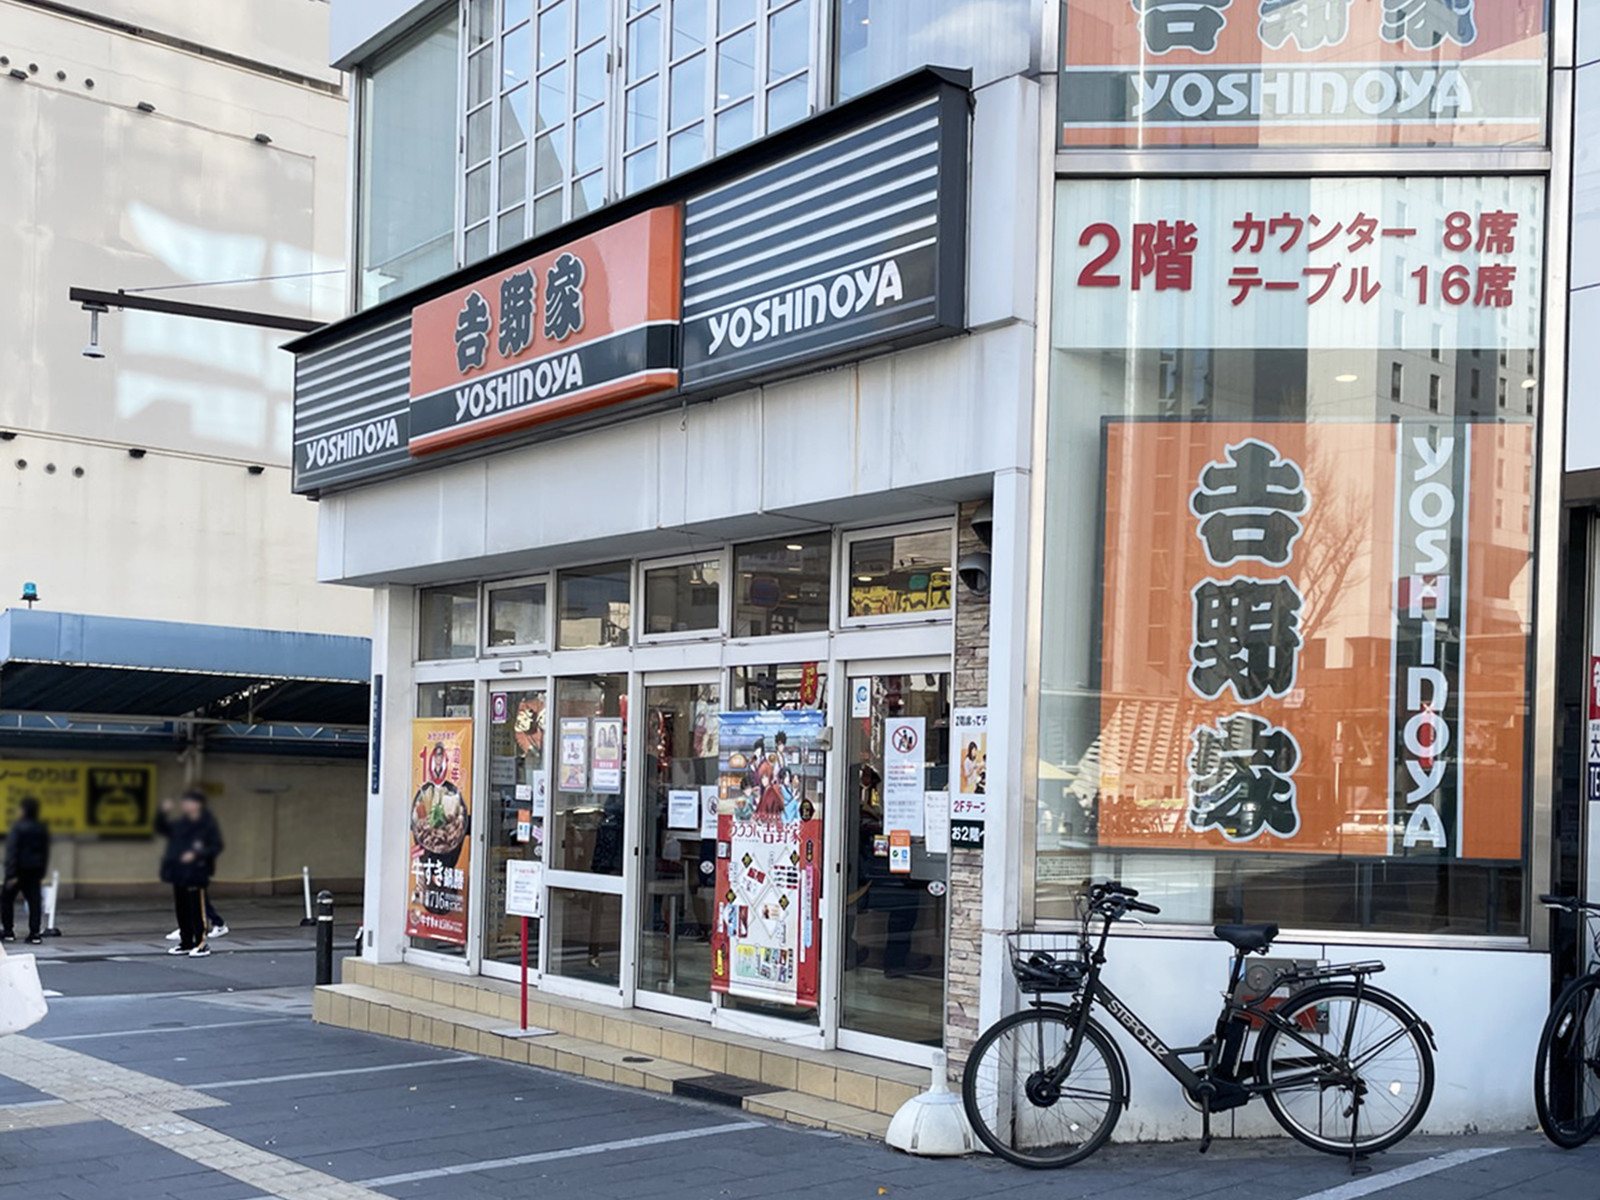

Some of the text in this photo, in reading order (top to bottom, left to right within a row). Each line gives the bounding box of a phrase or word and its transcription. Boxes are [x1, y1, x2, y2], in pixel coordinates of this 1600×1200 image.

[1130, 70, 1473, 117] YOSHINOYA
[1077, 210, 1519, 292] 2階 カウンター 8席
[1226, 264, 1517, 308] テーブル 16席
[454, 251, 587, 375] 吉野家
[707, 259, 904, 356] YOSHINOYA
[454, 351, 585, 422] YOSHINOYA
[304, 416, 400, 471] YOSHINOYA
[1188, 437, 1310, 843] 吉野家
[1402, 436, 1456, 849] YOSHINOYA
